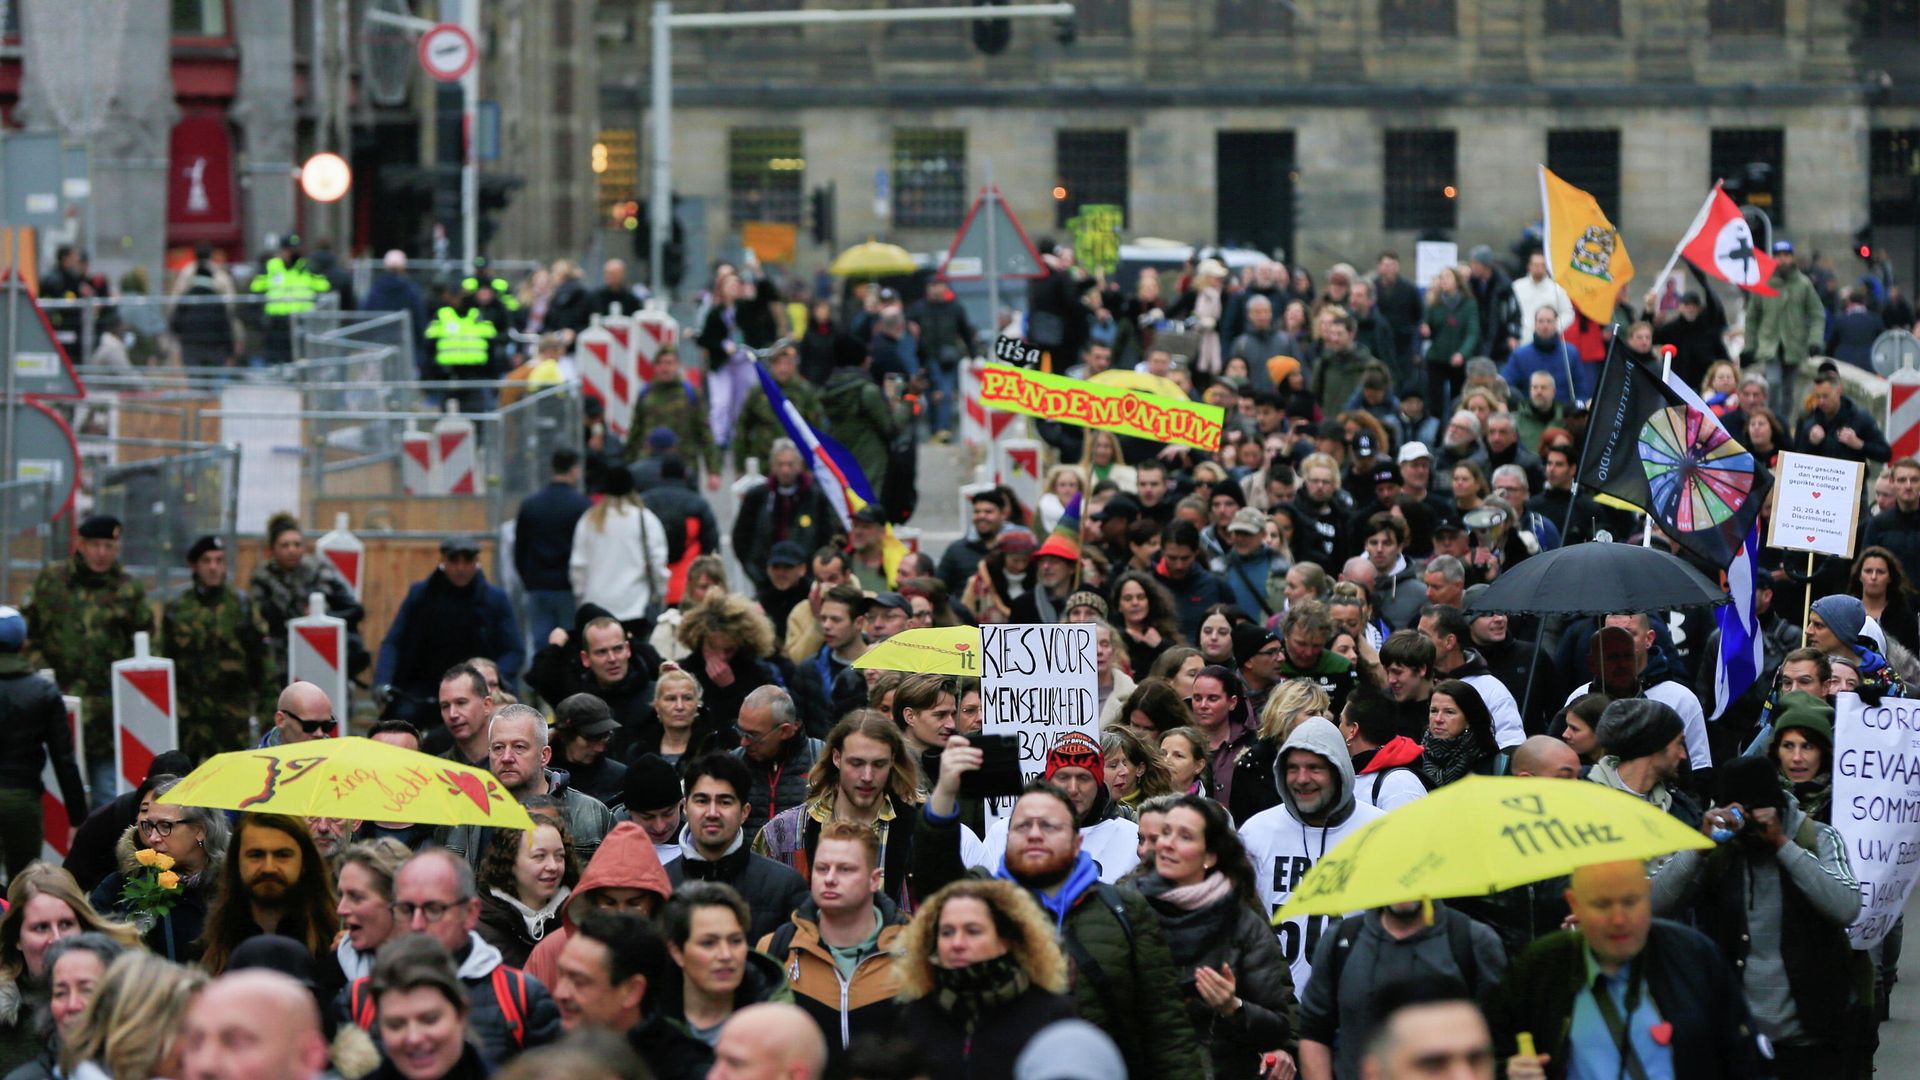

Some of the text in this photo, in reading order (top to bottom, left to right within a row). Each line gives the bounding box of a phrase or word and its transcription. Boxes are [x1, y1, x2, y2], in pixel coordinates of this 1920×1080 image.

[996, 337, 1040, 363] it's a
[982, 369, 1222, 451] PANDEMONIUM
[1794, 462, 1846, 476] Liever geschikte
[1812, 474, 1840, 483] verplicht
[1789, 478, 1815, 487] geprikte
[1791, 512, 1836, 524] Discriminatie!
[980, 626, 1096, 679] KIES VOOR
[1858, 838, 1894, 864] UW
